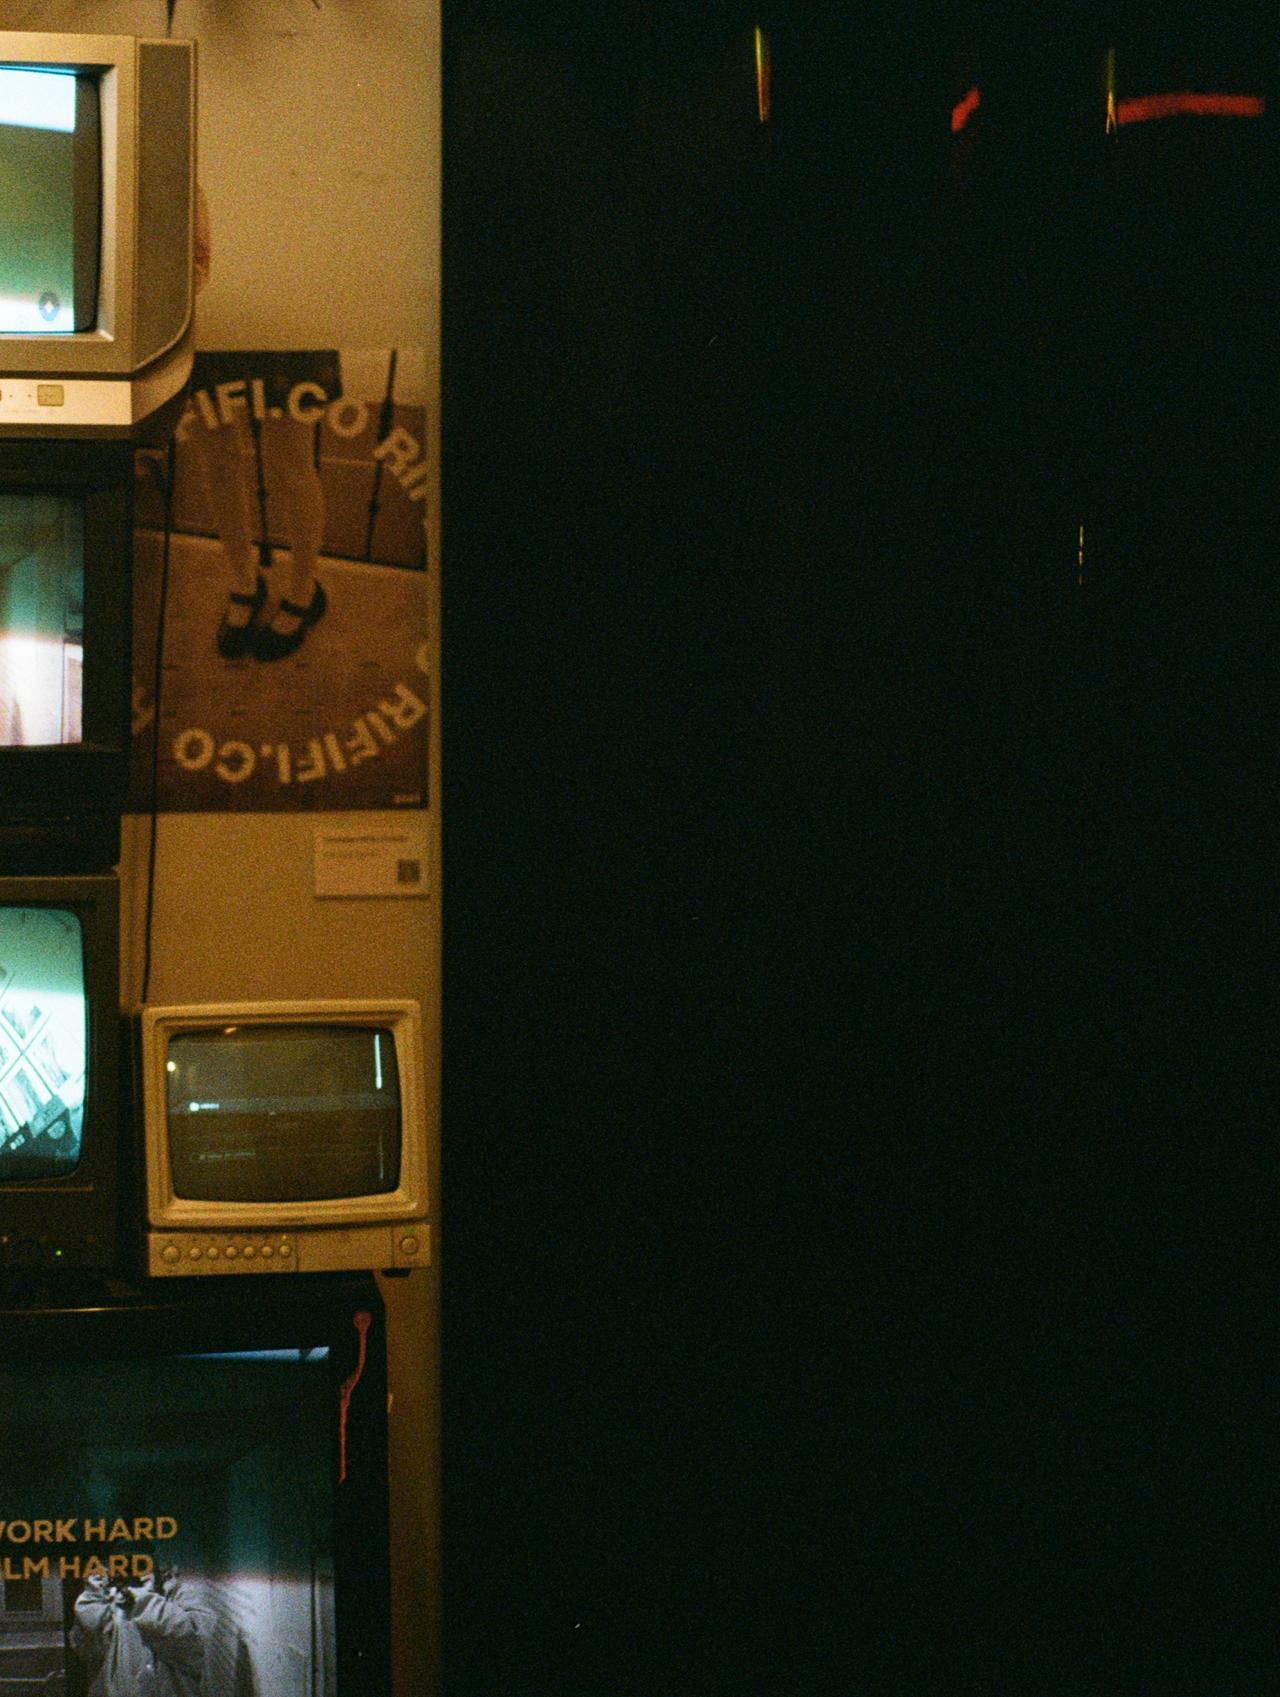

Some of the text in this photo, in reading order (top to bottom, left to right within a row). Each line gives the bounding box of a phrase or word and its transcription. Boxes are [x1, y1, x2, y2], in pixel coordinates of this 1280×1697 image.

[173, 683, 428, 784] RIFIFI.CO
[83, 1515, 179, 1543] HARD
[58, 1553, 156, 1580] HARD
